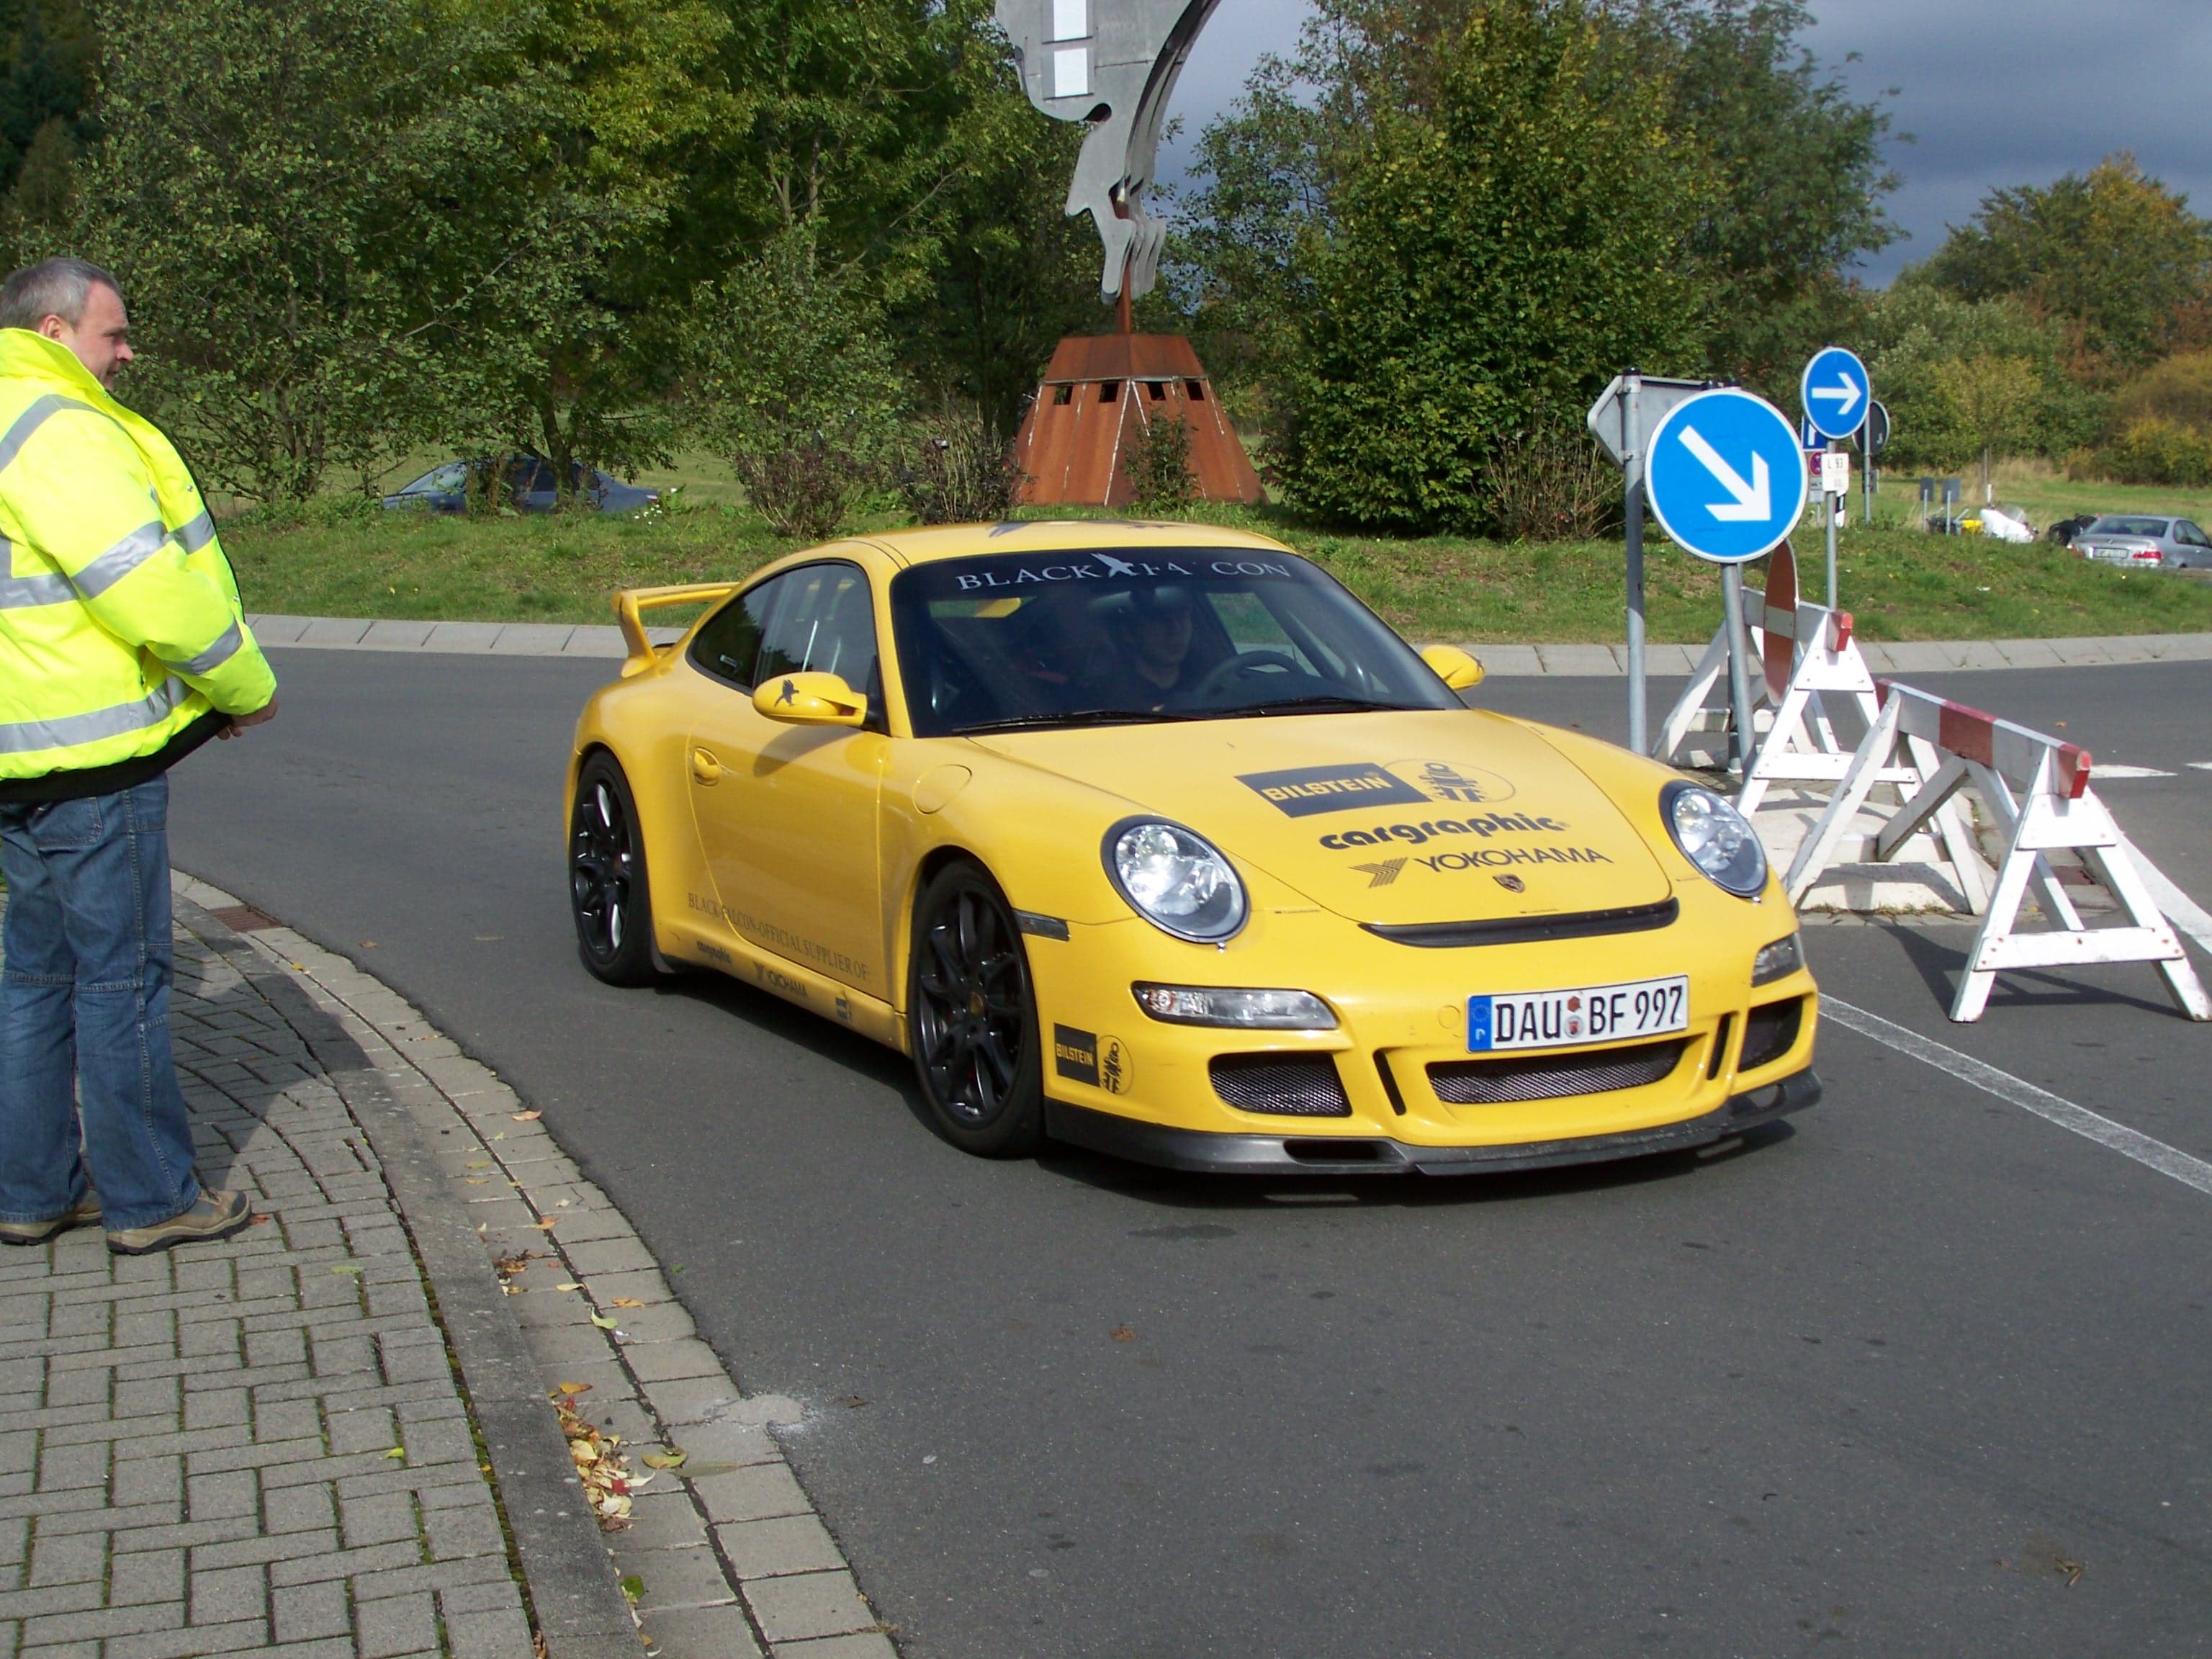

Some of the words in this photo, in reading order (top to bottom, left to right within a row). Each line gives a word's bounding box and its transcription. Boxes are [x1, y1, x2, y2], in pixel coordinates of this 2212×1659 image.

[957, 565, 1100, 590] BLACK
[1261, 776, 1393, 801] BILSTEIN
[1319, 812, 1565, 850] cargraphic
[1412, 847, 1614, 873] YOKOHAMA
[803, 938, 853, 974] SUPPLIER
[1494, 999, 1562, 1043] DAU
[1589, 992, 1627, 1035] BF
[1635, 984, 1683, 1030] 997
[1056, 1043, 1094, 1066] BILSTEIN
